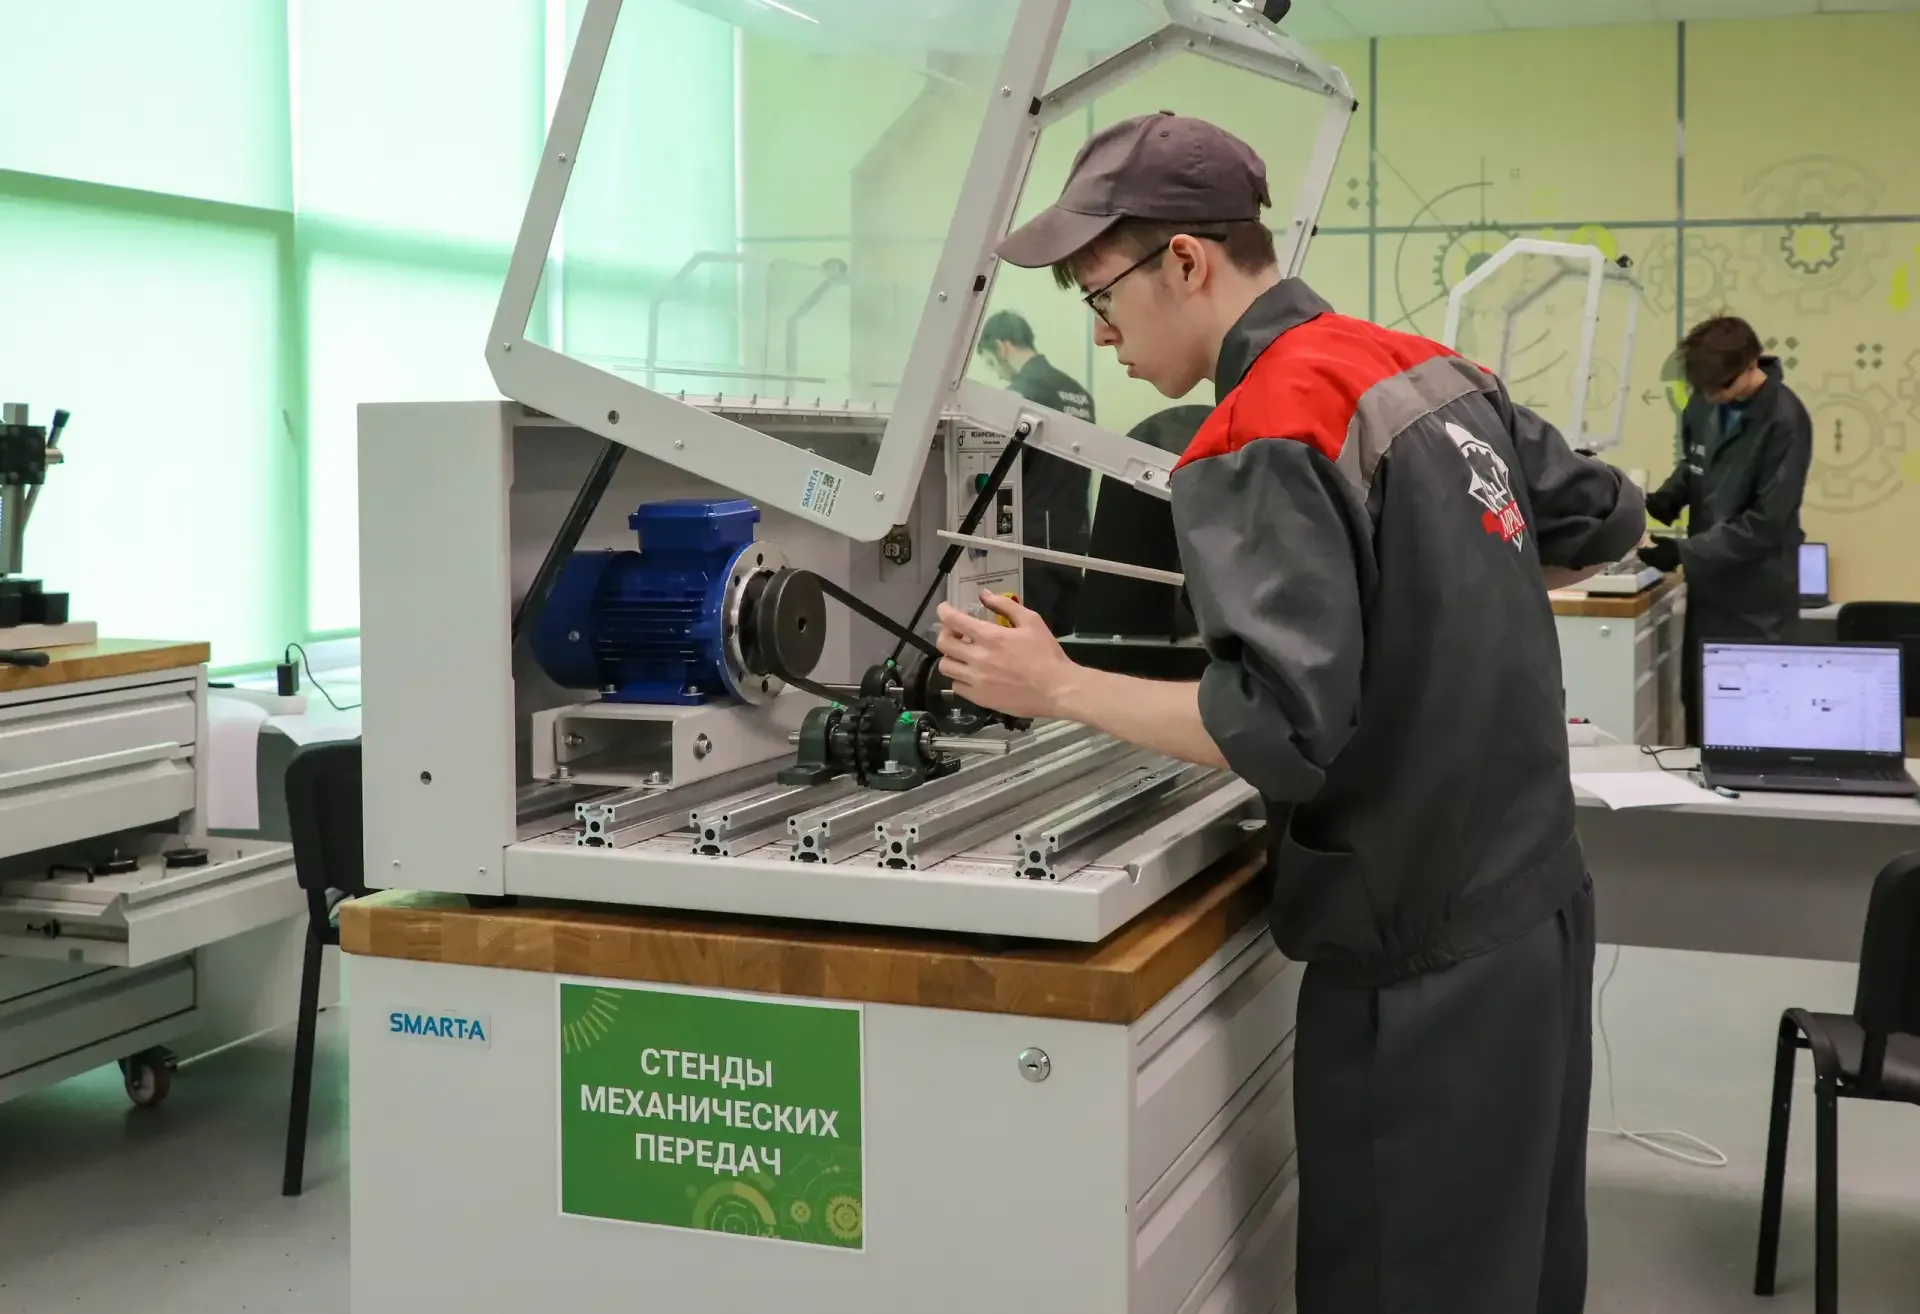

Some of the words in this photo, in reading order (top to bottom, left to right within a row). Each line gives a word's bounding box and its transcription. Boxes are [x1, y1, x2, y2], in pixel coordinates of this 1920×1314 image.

[641, 1048, 772, 1091] СТЕНДЫ
[580, 1084, 840, 1138] МЕХАНИЧЕСКИХ
[635, 1133, 781, 1176] ПЕРЕДАЧ
